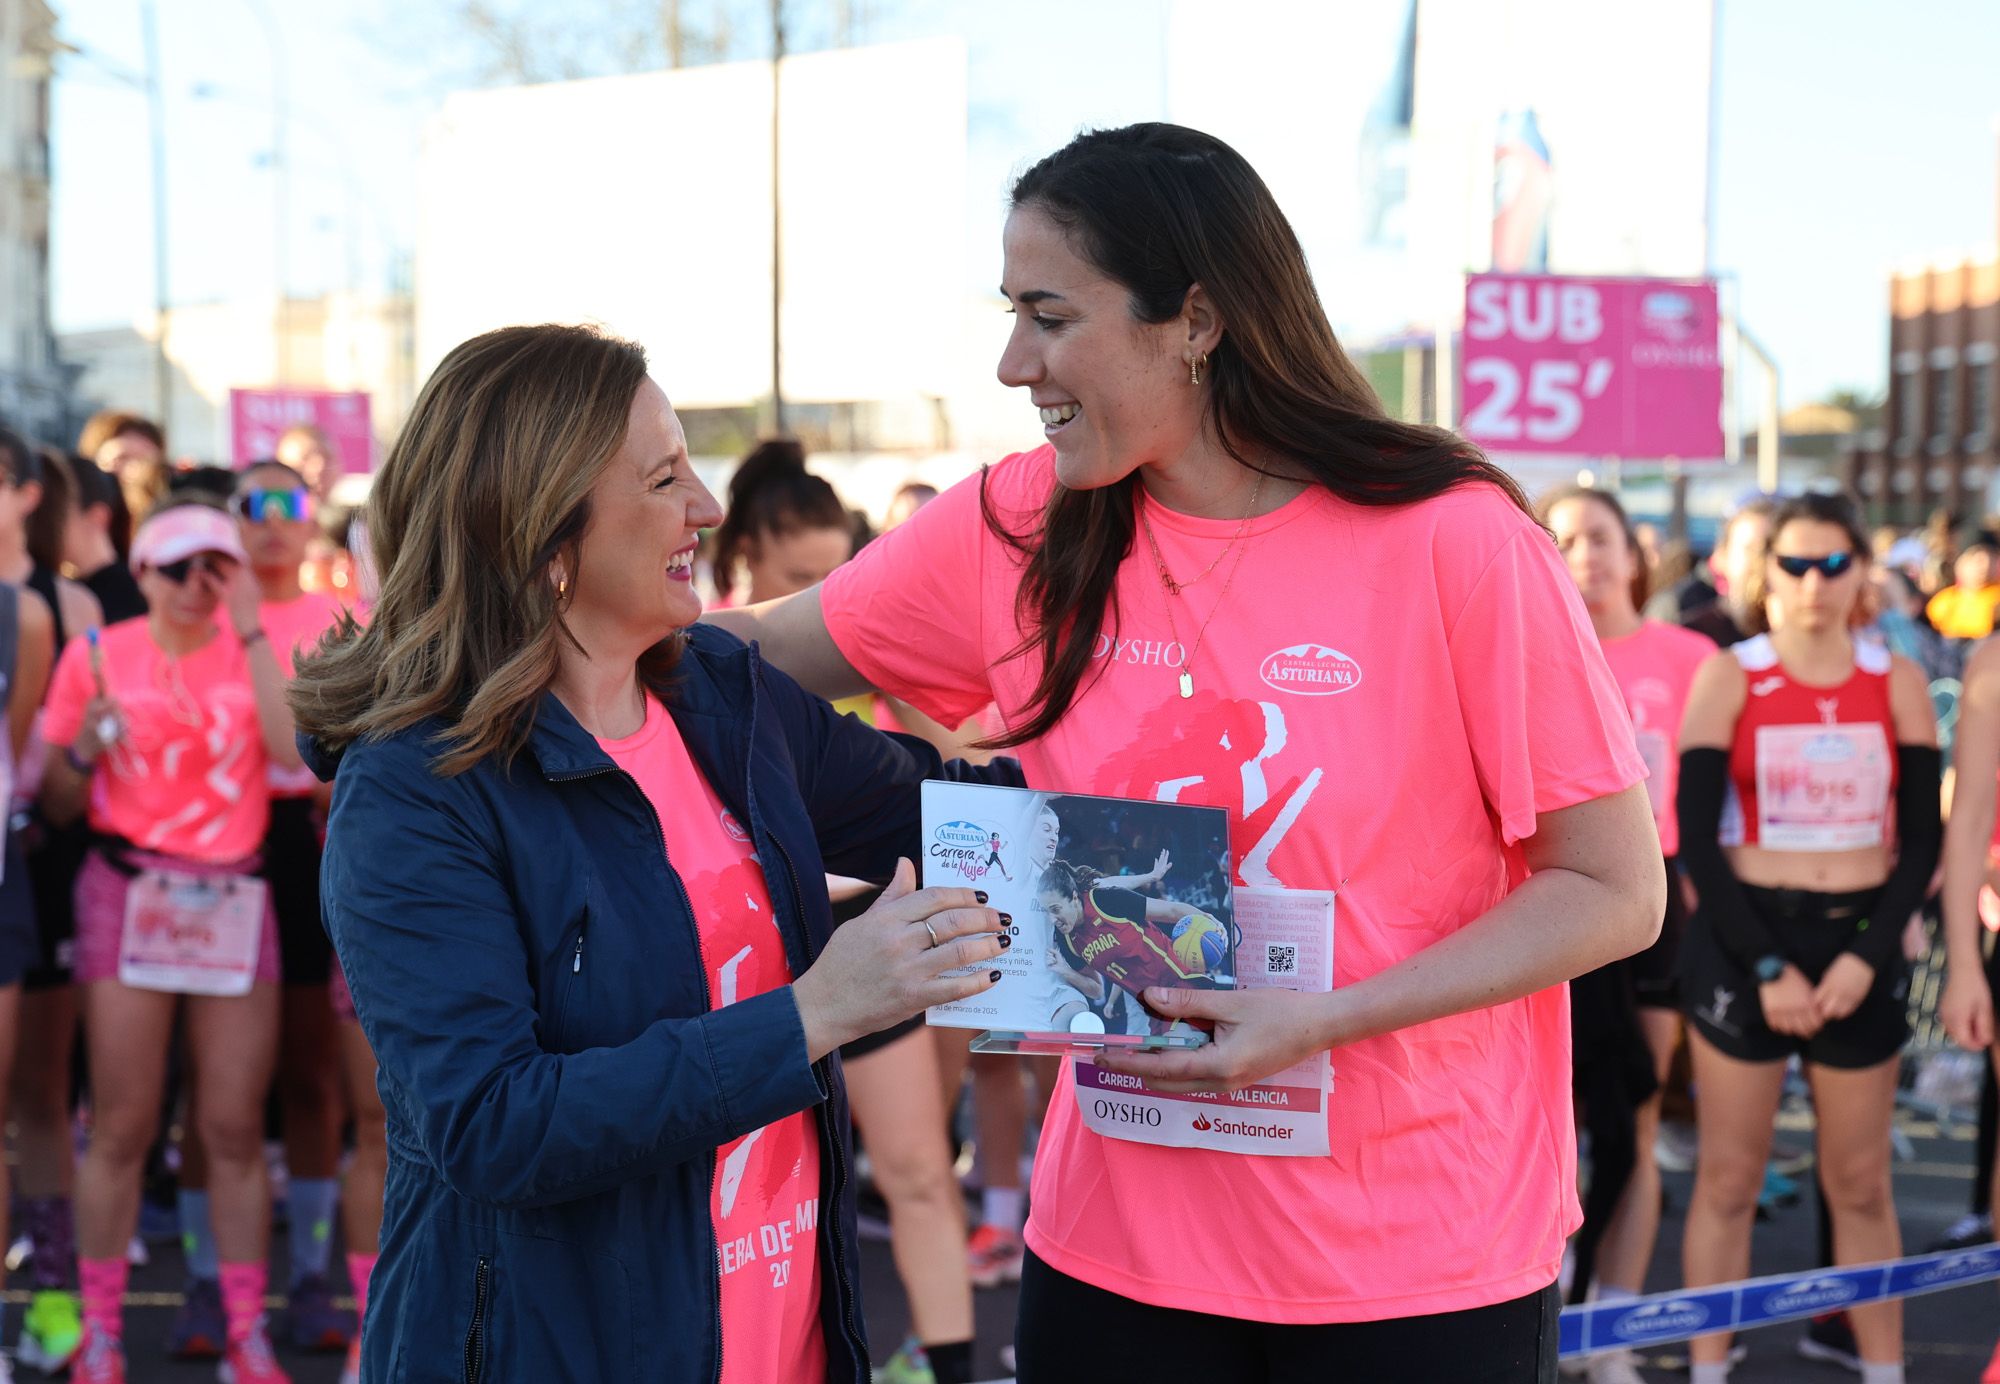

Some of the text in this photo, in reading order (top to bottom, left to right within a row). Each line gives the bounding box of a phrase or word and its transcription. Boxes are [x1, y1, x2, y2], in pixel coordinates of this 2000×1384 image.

[1467, 281, 1602, 343] SUB
[1266, 660, 1353, 684] ASTURIANA
[940, 829, 985, 843] ASTURIANA
[930, 843, 975, 860] Carrera
[941, 859, 991, 882] de la Mujer
[1106, 962, 1128, 980] 11
[974, 1006, 982, 1014] de
[1097, 1070, 1143, 1090] CARRERA
[1229, 1088, 1289, 1106] VALENCIA
[1094, 1099, 1294, 1140] OYSHO Santander
[760, 1219, 793, 1259] DE
